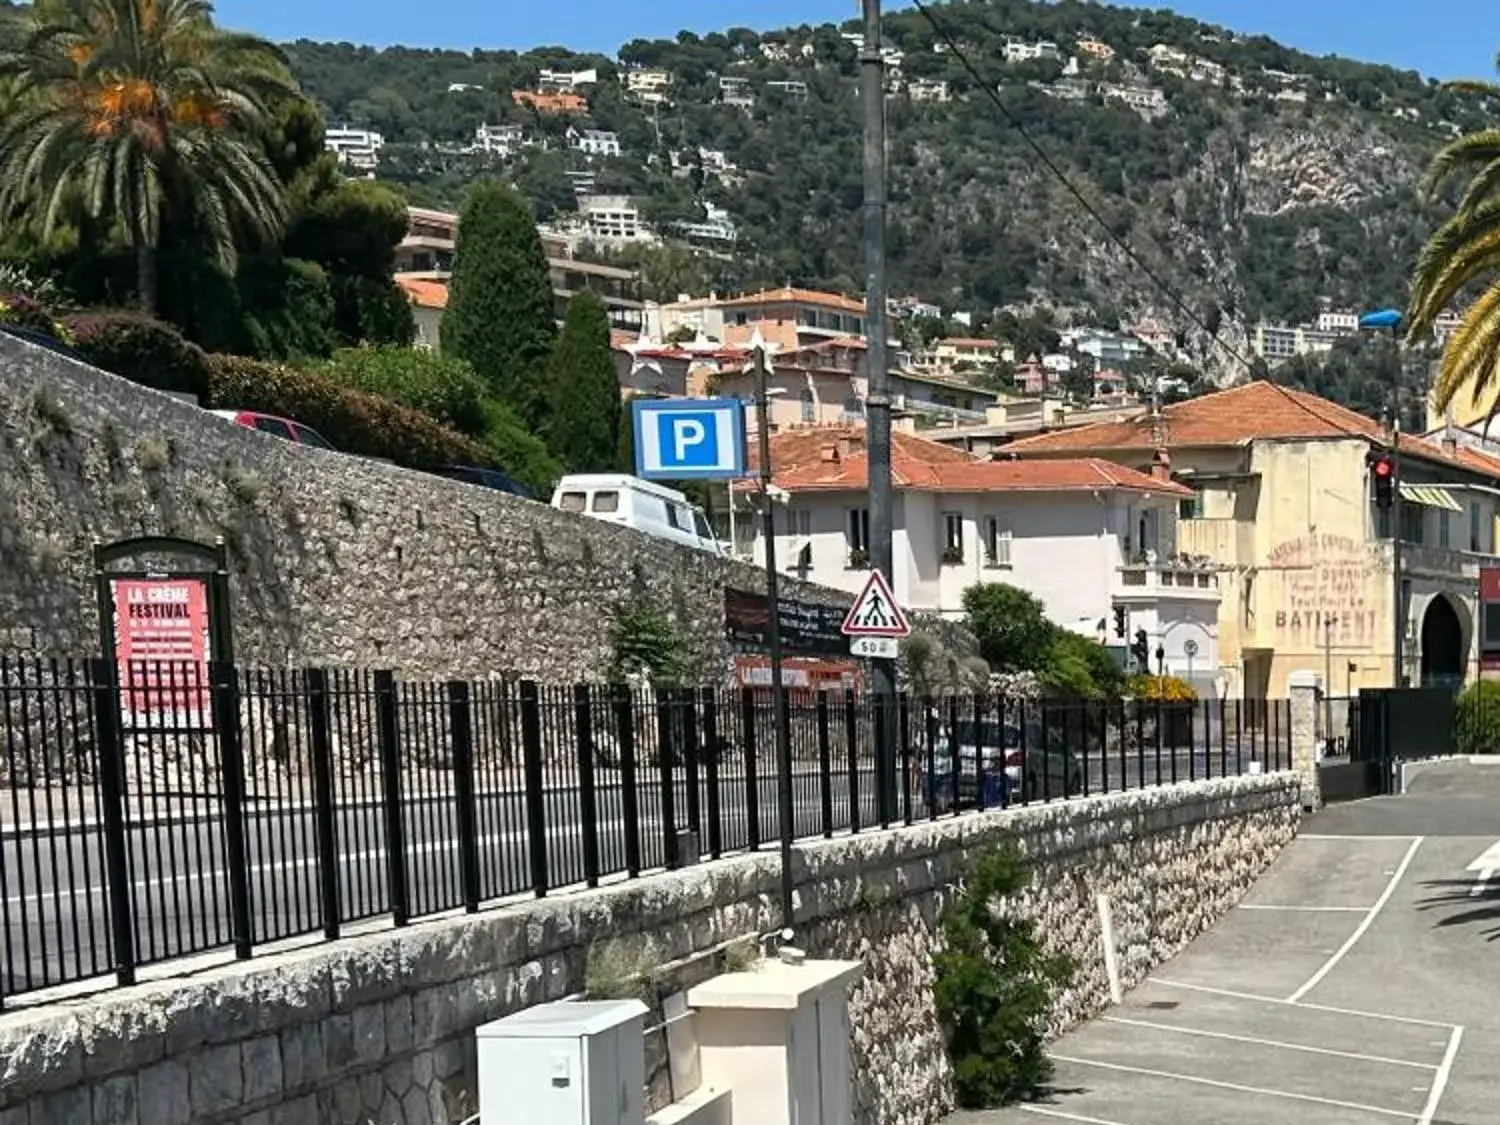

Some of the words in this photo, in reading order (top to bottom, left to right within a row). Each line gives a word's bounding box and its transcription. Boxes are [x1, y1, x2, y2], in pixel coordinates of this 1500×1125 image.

[673, 419, 705, 461] P
[128, 588, 143, 602] LA
[129, 603, 190, 618] FESTIVAL
